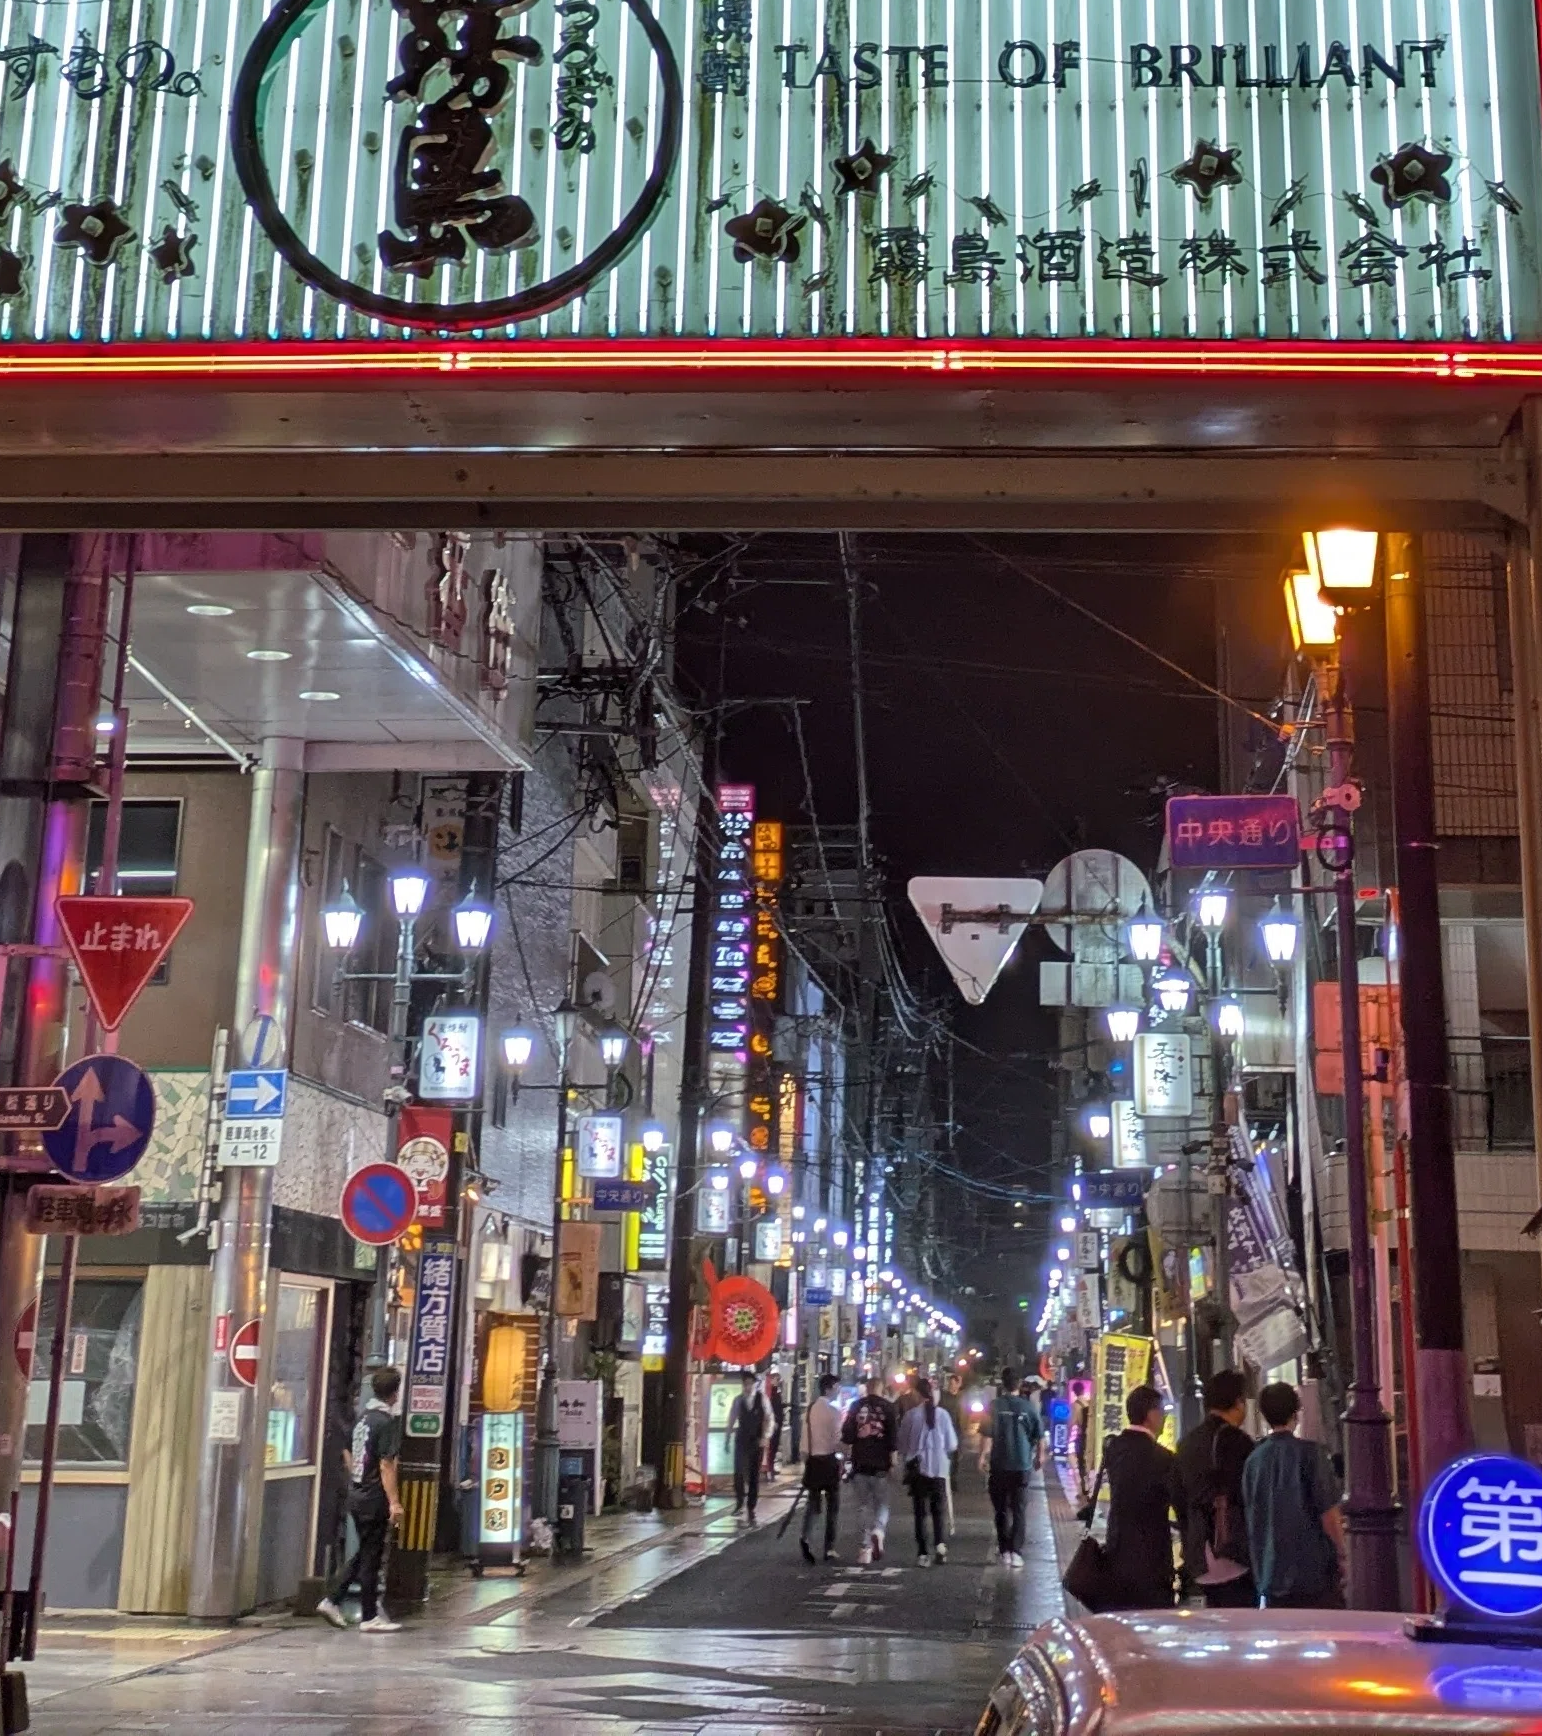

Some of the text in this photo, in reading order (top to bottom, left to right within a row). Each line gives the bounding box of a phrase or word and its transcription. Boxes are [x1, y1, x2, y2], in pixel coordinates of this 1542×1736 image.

[773, 34, 1448, 92] TASTE OF BRILLIANT
[867, 224, 1494, 288] 霧島酒造株式会社
[1176, 816, 1292, 848] 中央通り
[79, 921, 163, 952] 止まれ
[415, 1256, 453, 1373] 緒方質店
